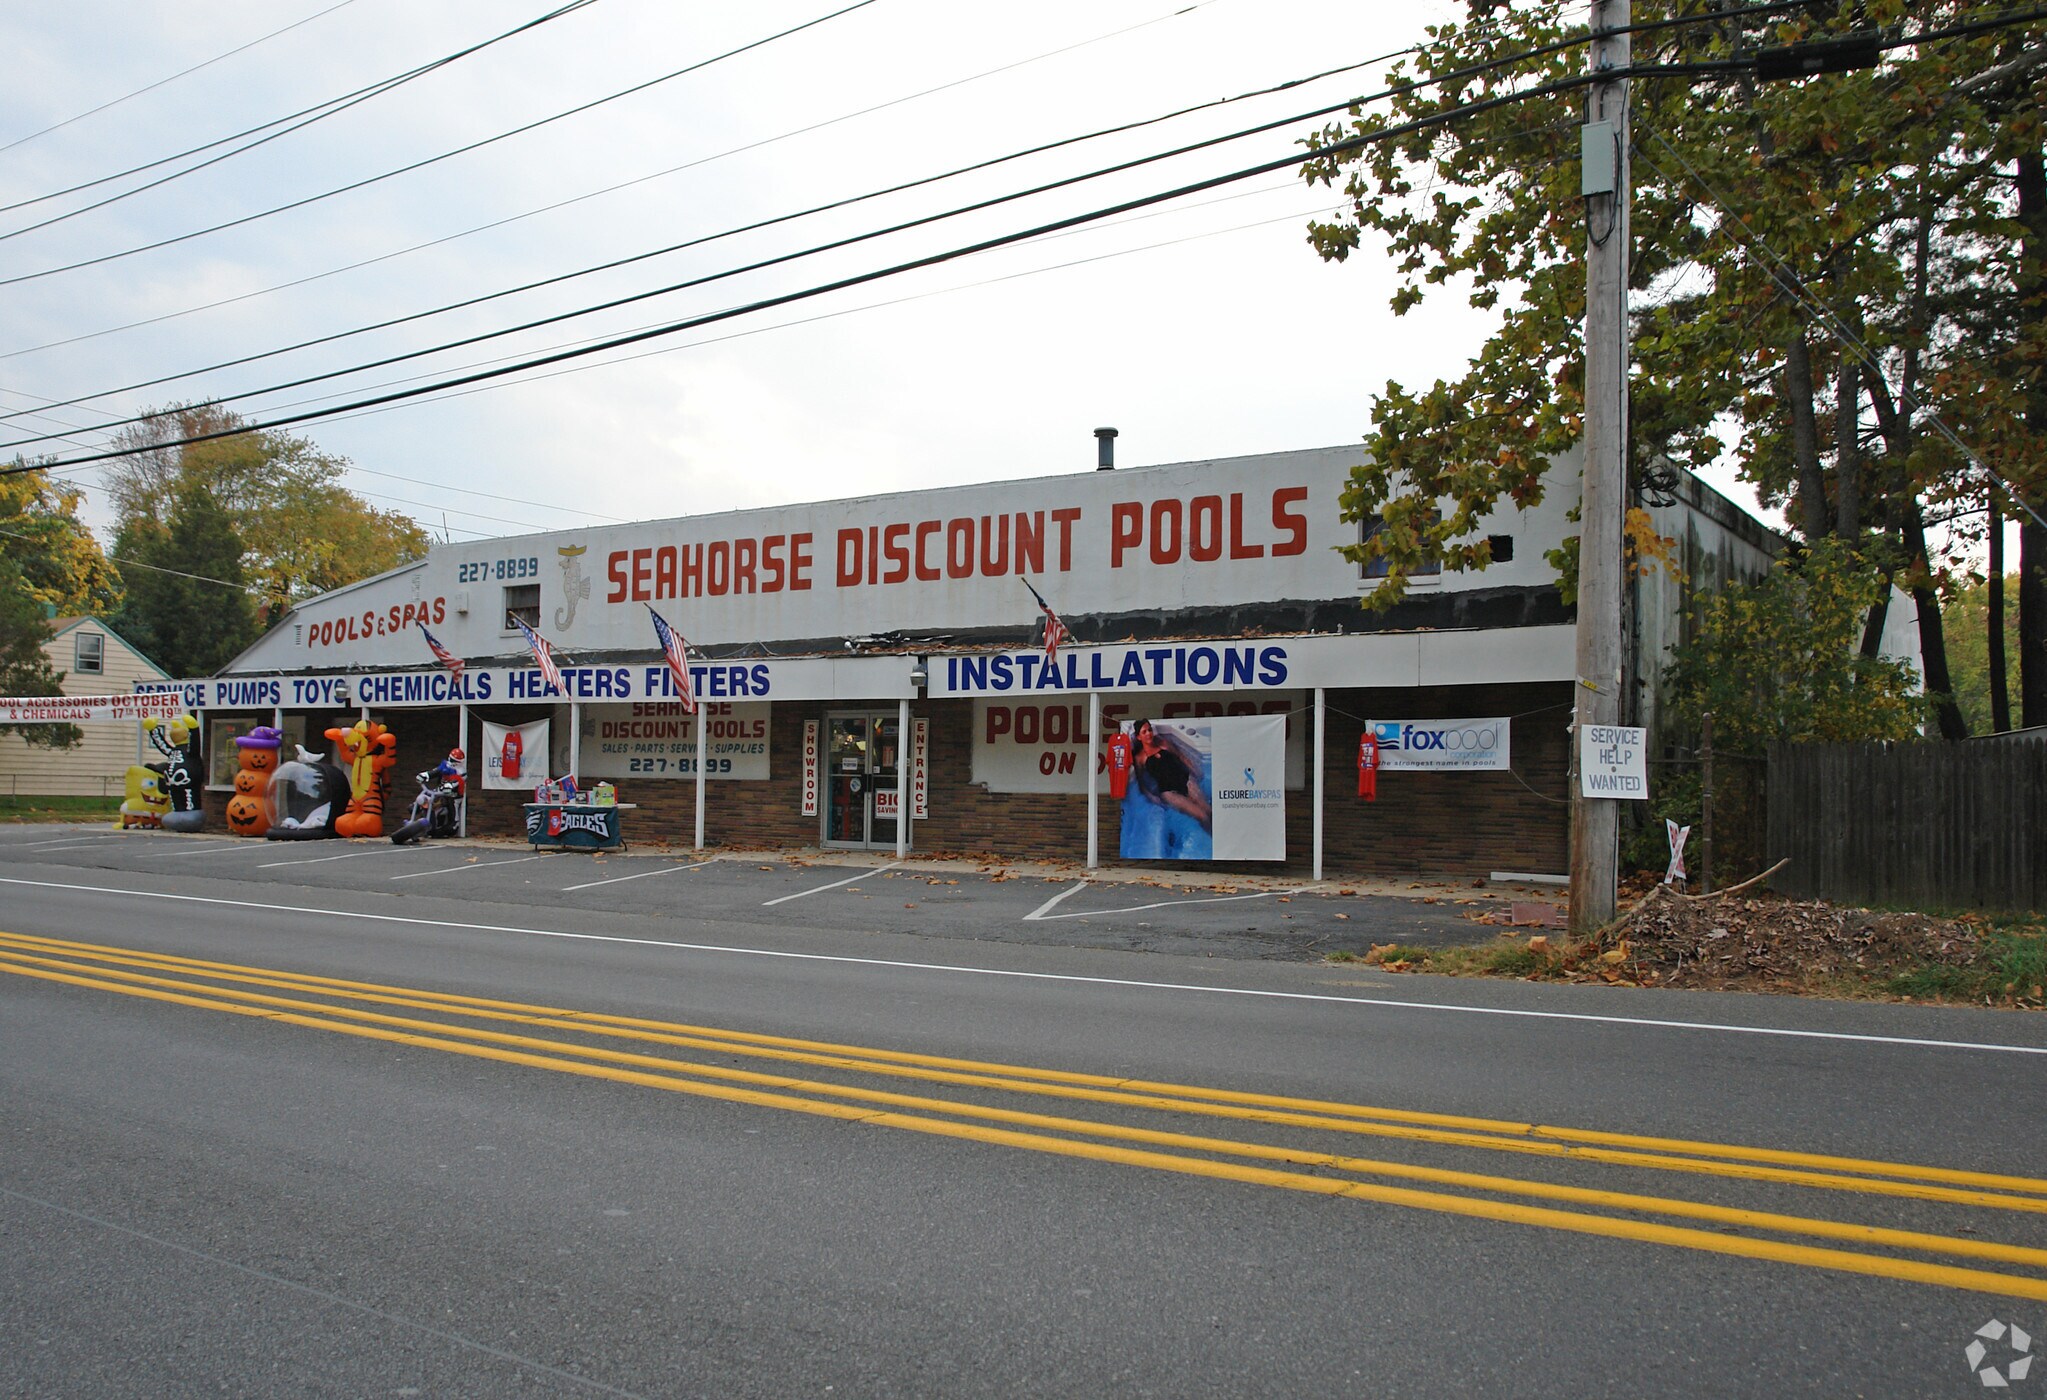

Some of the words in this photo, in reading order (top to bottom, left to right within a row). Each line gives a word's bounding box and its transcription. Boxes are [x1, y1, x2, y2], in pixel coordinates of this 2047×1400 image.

[607, 532, 813, 604] SEAHORSE
[836, 507, 1081, 587] DISCOUNT
[1111, 486, 1308, 569] POOLS
[308, 611, 376, 648] POOLS
[388, 597, 446, 633] SPAS
[947, 646, 1289, 691] INSTALLATIONS
[216, 680, 281, 705] PUMPS
[359, 672, 492, 703] CHEMICALS
[509, 668, 631, 698] HEATERS
[646, 664, 771, 697] FITERS
[27, 697, 107, 708] ACCESSORIES
[111, 694, 180, 707] OCTOBER
[9, 708, 18, 719] &
[22, 708, 91, 719] CHEMICALS
[111, 708, 134, 719] 17TH
[136, 707, 158, 719] 18TH
[160, 706, 182, 719] 19TH
[602, 721, 691, 738] DISCOUNT
[1591, 728, 1639, 745] SERVICE
[1402, 722, 1498, 755] foxpool
[602, 743, 628, 753] SALES
[635, 743, 665, 753] PARTS
[715, 743, 765, 754] SUPPLIES
[1600, 749, 1632, 765] HELP
[805, 724, 815, 811] SHOWROOM
[915, 723, 925, 814] ENTRANCE
[1039, 751, 1077, 775] ON
[1589, 774, 1641, 791] WANTED
[1222, 801, 1279, 809] spasbyleisurebay.com
[560, 812, 610, 838] EAGLES
